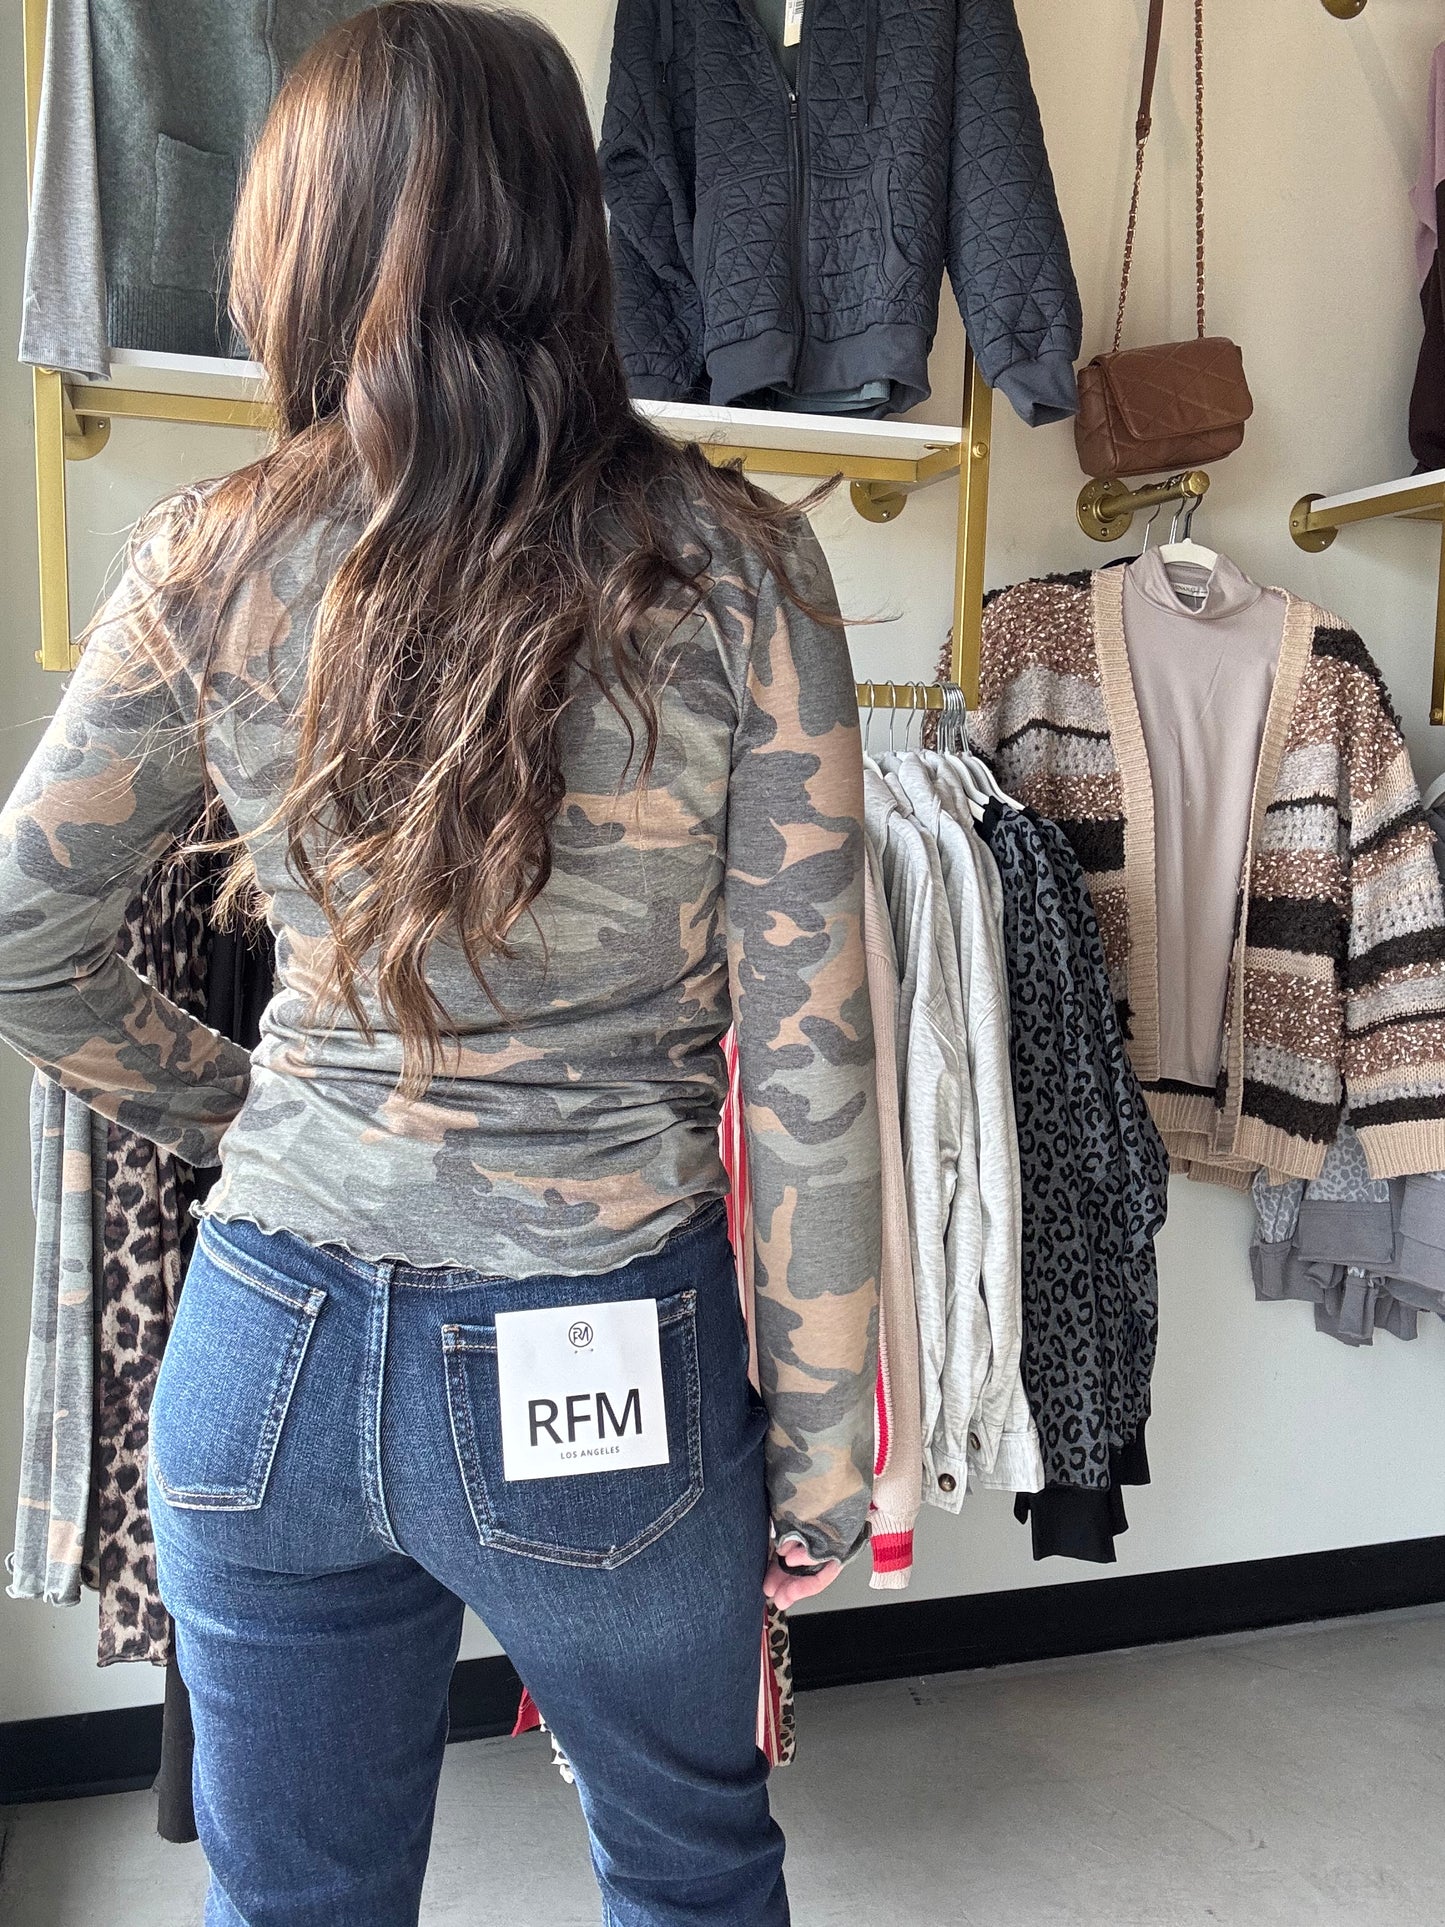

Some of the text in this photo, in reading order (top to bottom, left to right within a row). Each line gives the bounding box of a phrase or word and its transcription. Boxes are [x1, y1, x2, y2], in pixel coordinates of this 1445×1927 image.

[528, 1388, 643, 1447] RFM
[560, 1446, 620, 1460] LOS ANGELES
